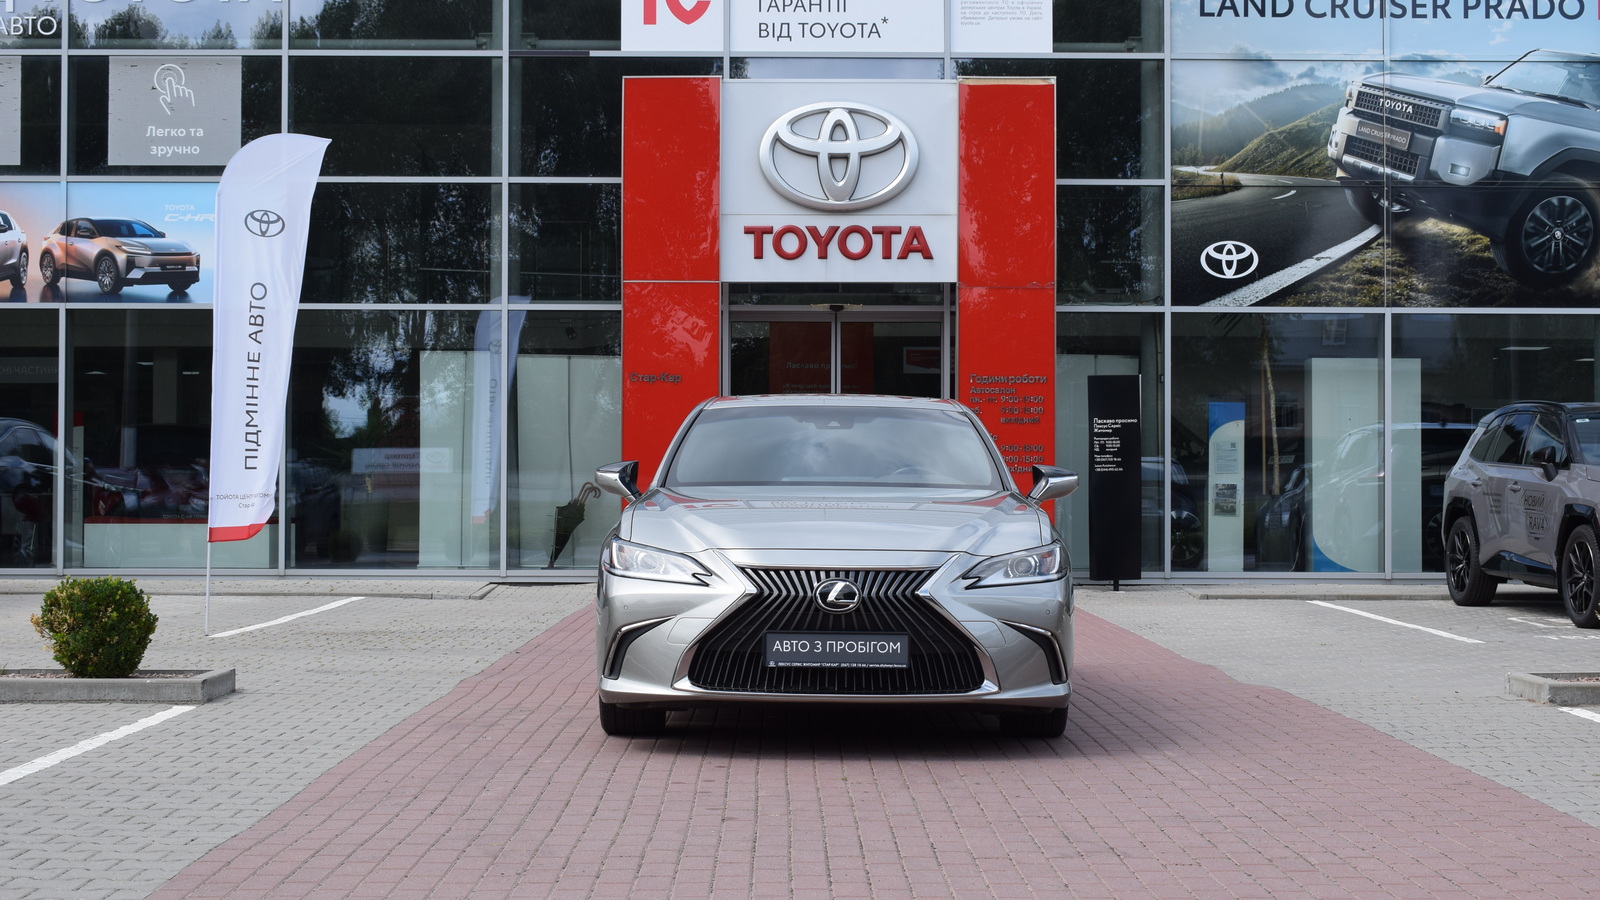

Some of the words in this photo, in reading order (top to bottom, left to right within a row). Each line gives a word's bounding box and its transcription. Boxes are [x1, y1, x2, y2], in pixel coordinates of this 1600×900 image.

[1199, 0, 1291, 17] LAND
[1304, 0, 1453, 19] CRUISER
[1463, 0, 1576, 20] PRADO
[758, 23, 792, 41] ВІД
[1379, 98, 1413, 113] TOYOTA
[145, 126, 187, 137] Легко
[190, 128, 204, 137] та
[1358, 125, 1371, 134] LAND
[1371, 129, 1391, 139] CRUISER
[1390, 133, 1407, 144] PRADO
[150, 146, 200, 157] зручно
[744, 225, 934, 260] TOYOTA
[248, 281, 268, 345] АВТО
[629, 372, 682, 384] Стар-Кар
[969, 374, 1007, 384] Години
[1008, 374, 1047, 385] роботи
[969, 386, 1016, 394] Автосалон
[244, 351, 262, 470] ПІДМІННЕ
[1000, 416, 1040, 424] вихідний
[1523, 493, 1546, 508] НОВИЙ
[1528, 515, 1545, 532] RAV4
[773, 640, 810, 652] АВТО
[826, 641, 901, 653] ПРОБІГОМ
